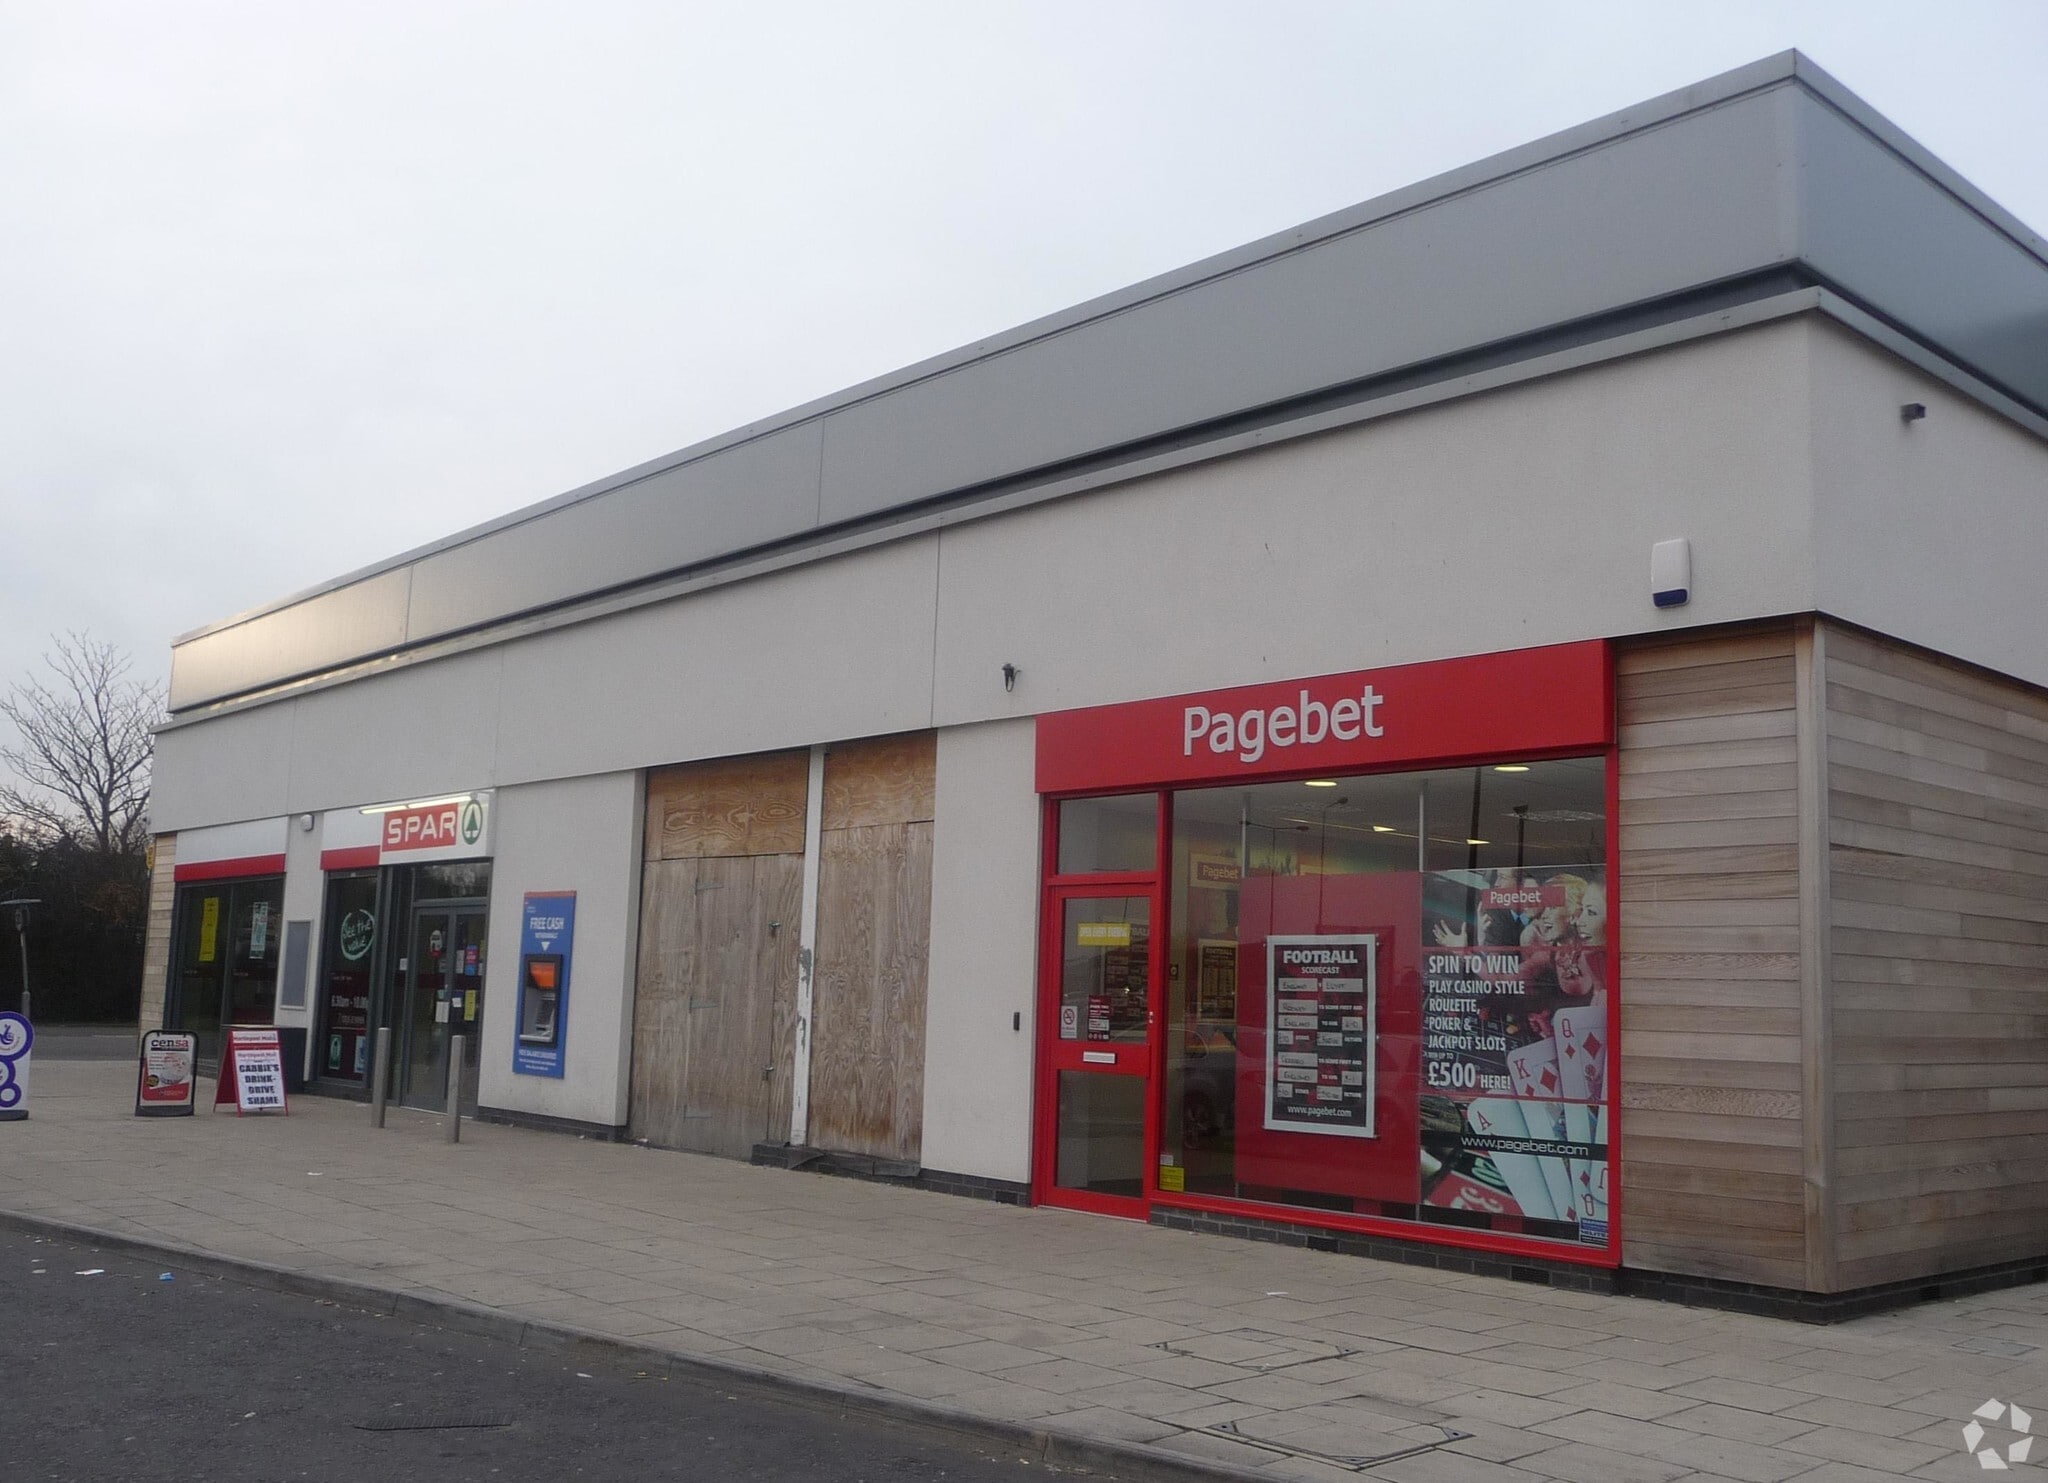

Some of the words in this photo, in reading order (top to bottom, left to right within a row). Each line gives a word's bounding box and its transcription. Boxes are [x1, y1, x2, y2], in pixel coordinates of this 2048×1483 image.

[1184, 685, 1384, 763] Pagebet
[387, 810, 456, 845] SPAR
[1202, 864, 1239, 880] Pagebet
[1490, 890, 1541, 906] Pagebet
[1283, 950, 1358, 964] FOOTBALL
[1429, 955, 1460, 974] SPIN
[1463, 955, 1482, 974] TO
[1486, 955, 1520, 974] WIN
[1301, 966, 1340, 974] SCORECAST
[1429, 980, 1451, 994] PLAY
[1454, 980, 1492, 994] CASINO
[1495, 980, 1525, 994] STYLE
[1429, 998, 1480, 1014] ROULETTE,
[1429, 1018, 1461, 1031] POKER
[1463, 1018, 1472, 1031] &
[151, 1038, 189, 1048] censa
[1428, 1035, 1473, 1050] JACKPOT
[1475, 1037, 1506, 1051] SLOTS
[1428, 1061, 1476, 1087] £500
[1480, 1074, 1511, 1090] HERE!
[248, 1085, 275, 1094] DRIVE
[247, 1096, 279, 1105] SHAME
[1287, 1106, 1352, 1118] www.pagebet.com
[1461, 1136, 1589, 1156] www.pagebet.com
